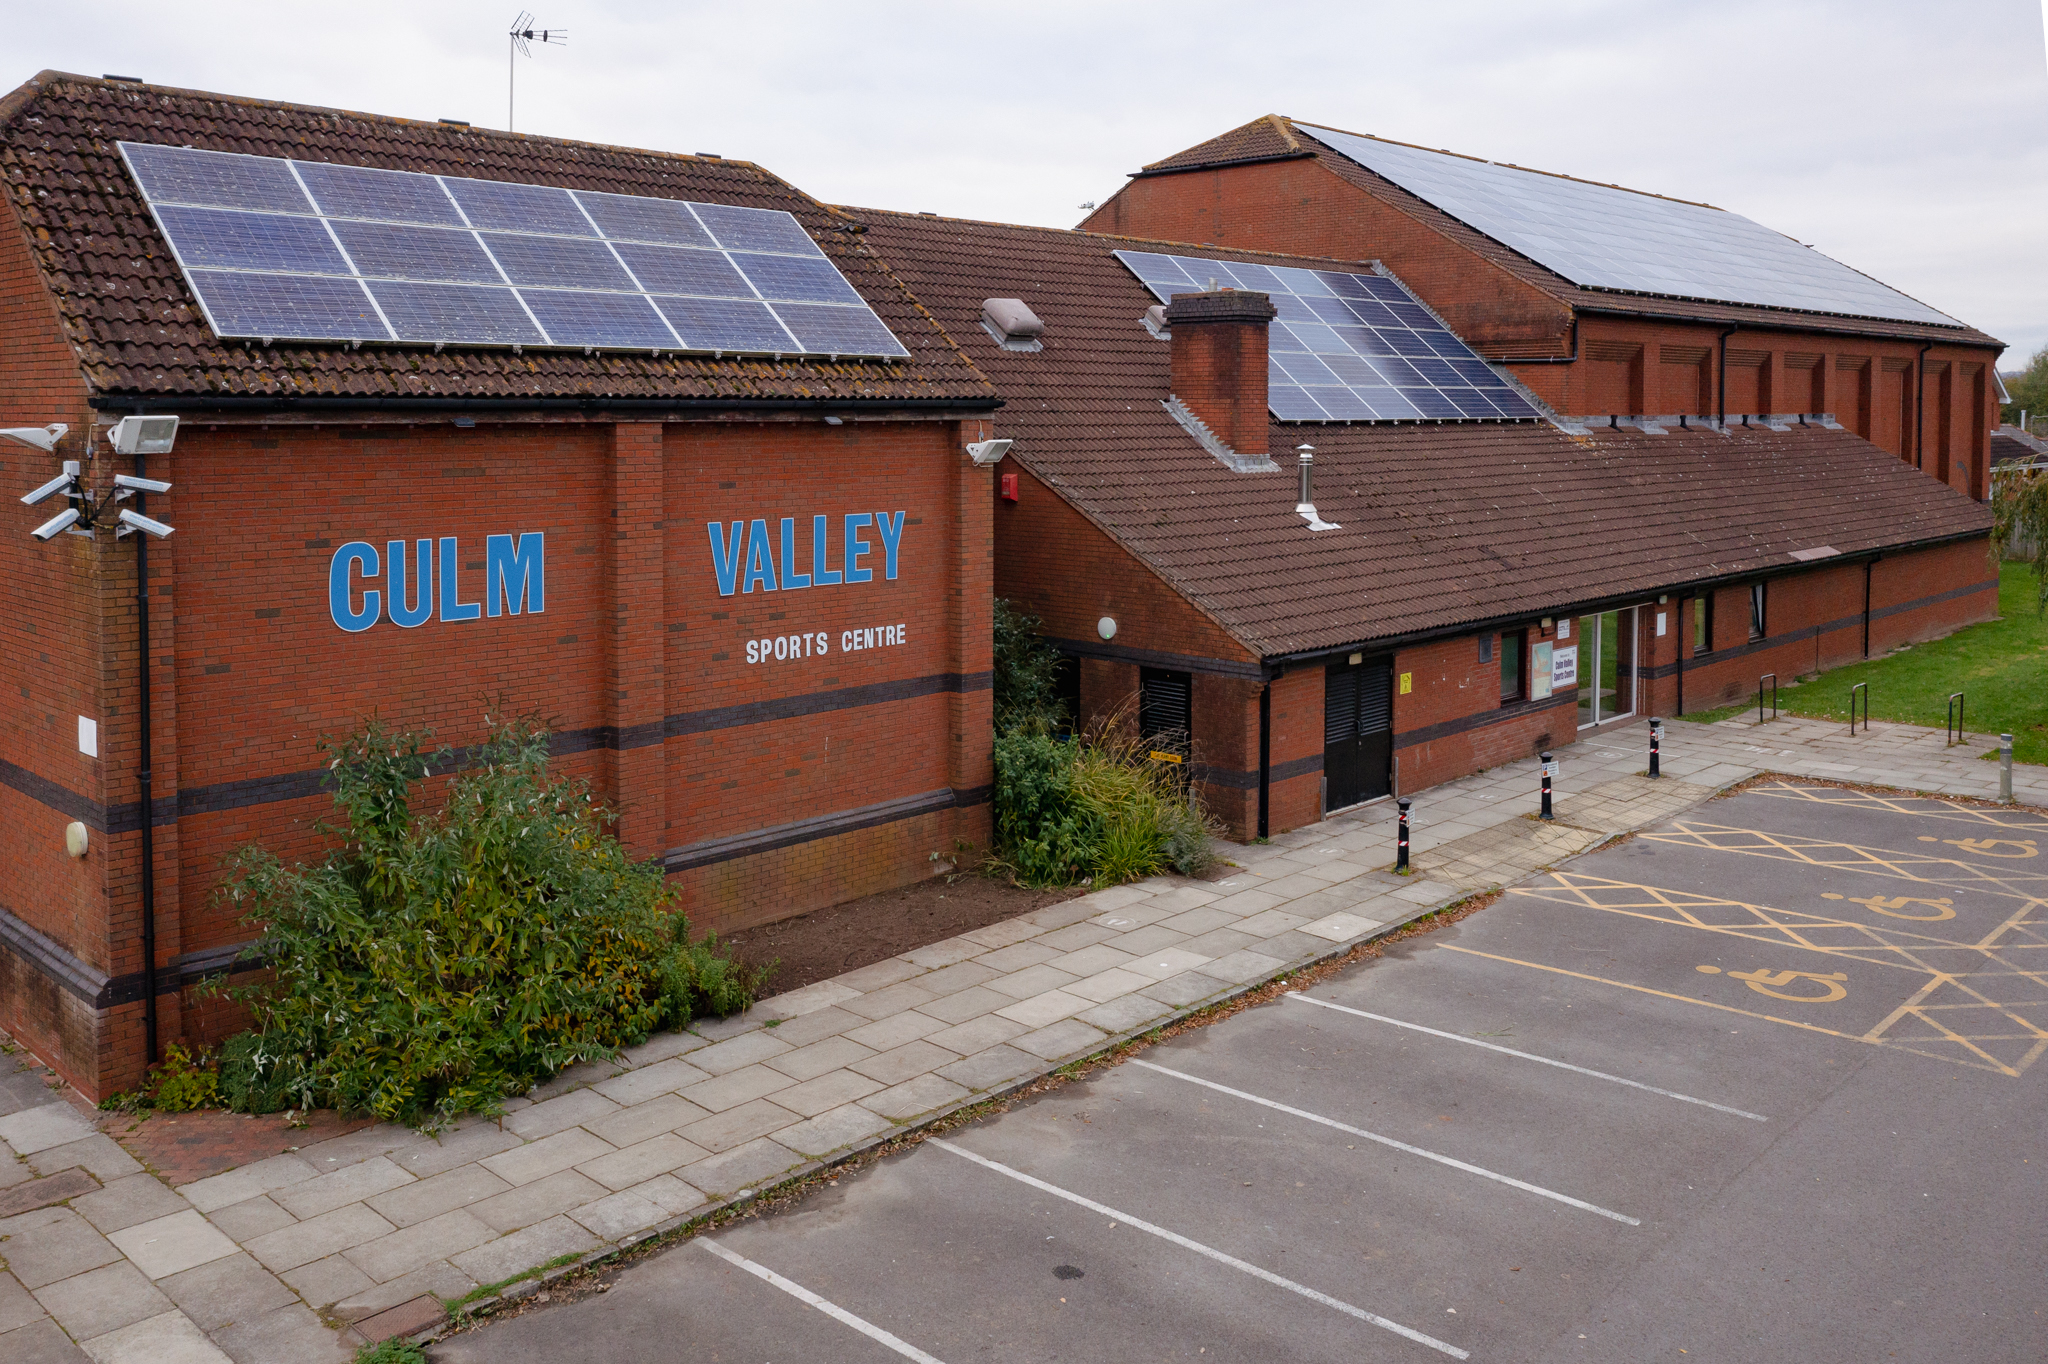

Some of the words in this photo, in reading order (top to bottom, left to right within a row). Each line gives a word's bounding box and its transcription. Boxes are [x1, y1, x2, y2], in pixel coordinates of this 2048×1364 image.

[329, 532, 544, 632] CULM
[707, 511, 906, 596] VALLEY
[746, 632, 828, 664] SPORTS
[841, 623, 906, 652] CENTRE
